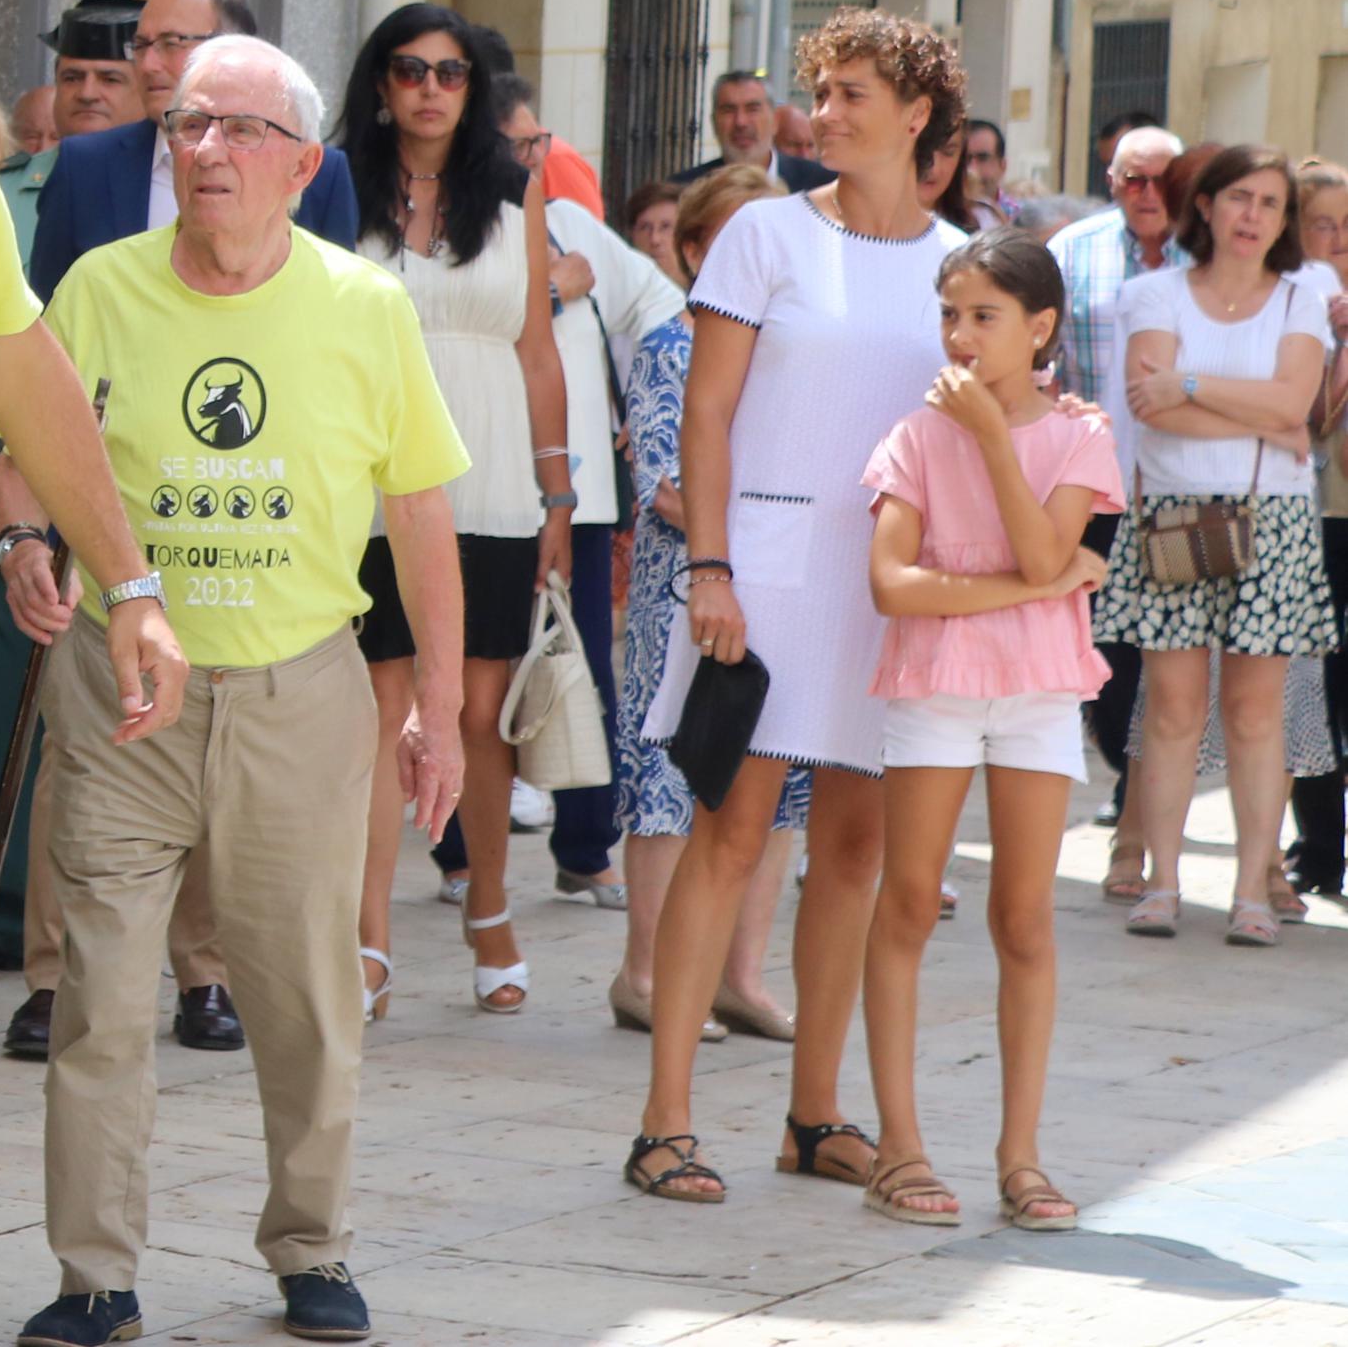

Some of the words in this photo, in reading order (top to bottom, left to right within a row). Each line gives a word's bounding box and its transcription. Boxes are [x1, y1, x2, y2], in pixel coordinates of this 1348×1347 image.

[159, 456, 186, 479] SE
[193, 456, 285, 480] BUSCAN
[144, 543, 292, 570] TORQUEMADA
[185, 576, 255, 608] 2022
